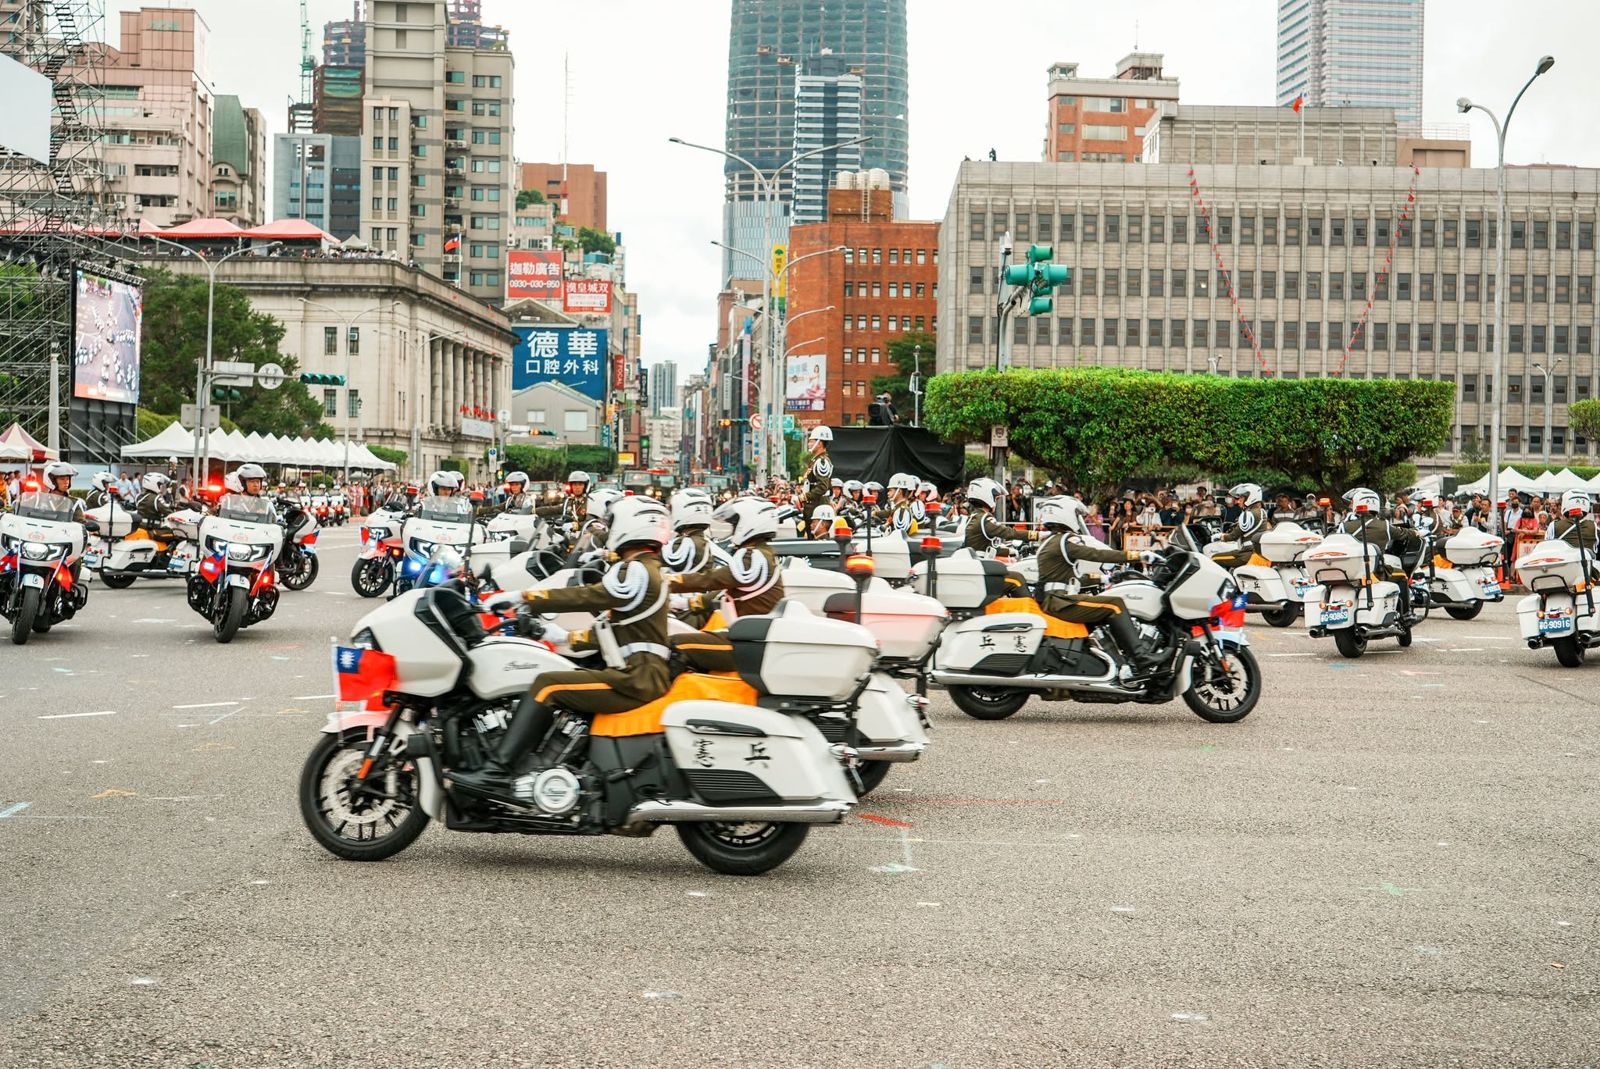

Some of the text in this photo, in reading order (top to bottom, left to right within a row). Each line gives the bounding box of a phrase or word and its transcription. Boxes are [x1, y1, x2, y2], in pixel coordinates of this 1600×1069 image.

[527, 331, 598, 358] 德華
[526, 360, 599, 375] 口腔外科
